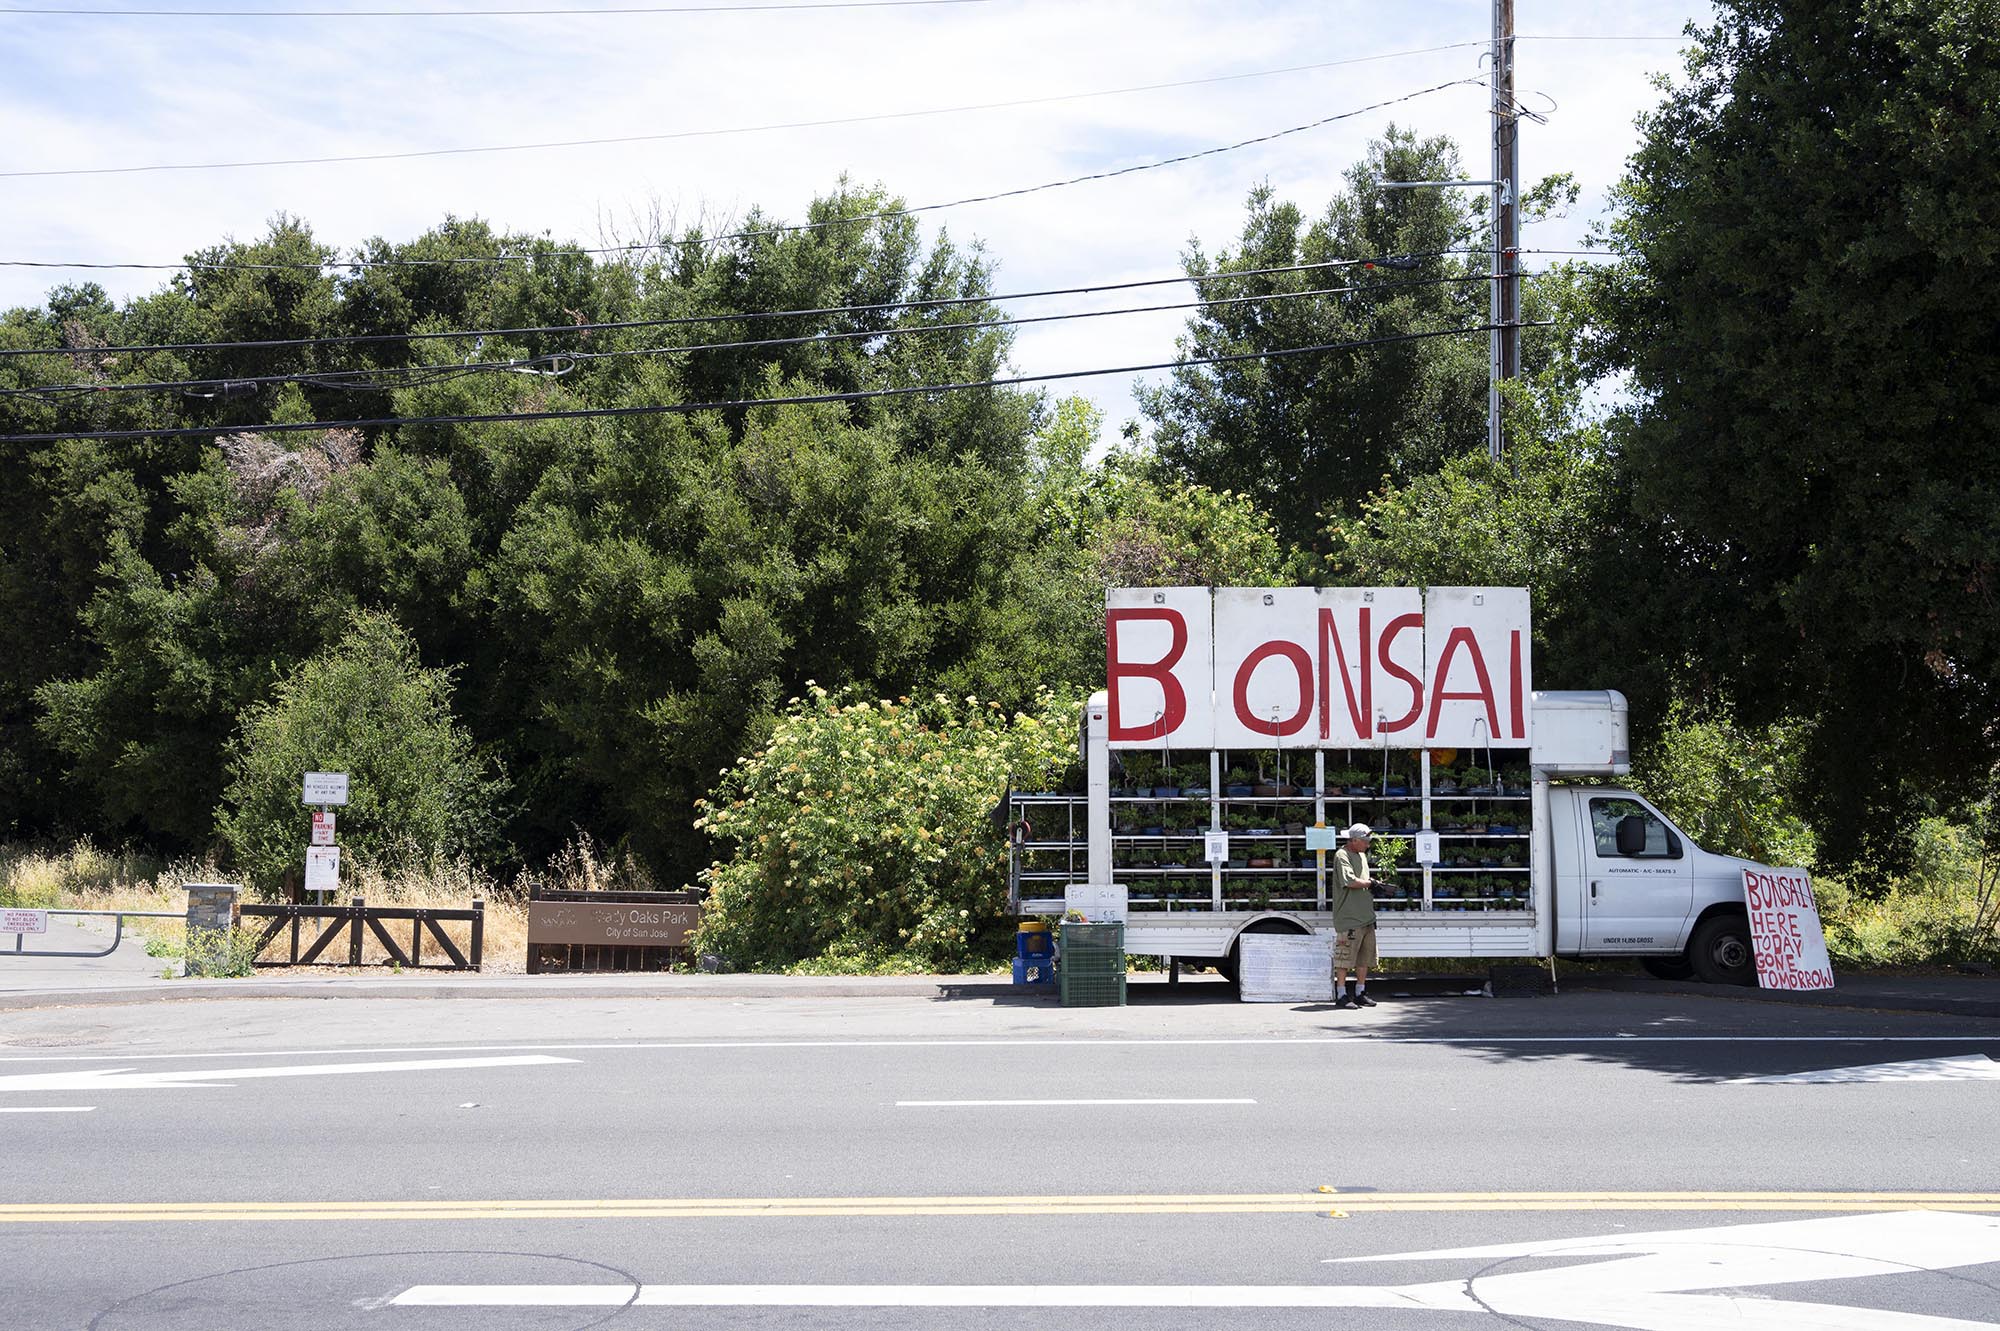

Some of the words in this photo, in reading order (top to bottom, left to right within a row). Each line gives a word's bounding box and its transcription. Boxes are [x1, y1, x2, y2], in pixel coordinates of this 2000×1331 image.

[1107, 607, 1526, 742] BONSAI
[314, 813, 323, 822] NO
[1745, 871, 1816, 912] BONSAI!
[629, 910, 659, 924] Oaks
[662, 910, 689, 924] Park
[1752, 912, 1801, 938] HERE
[606, 927, 622, 940] City
[623, 928, 631, 937] of
[632, 928, 648, 938] San
[650, 929, 668, 938] Jose
[1752, 934, 1802, 958] TODAY
[1755, 953, 1798, 973] GONE
[1757, 967, 1833, 989] TOMORROW
